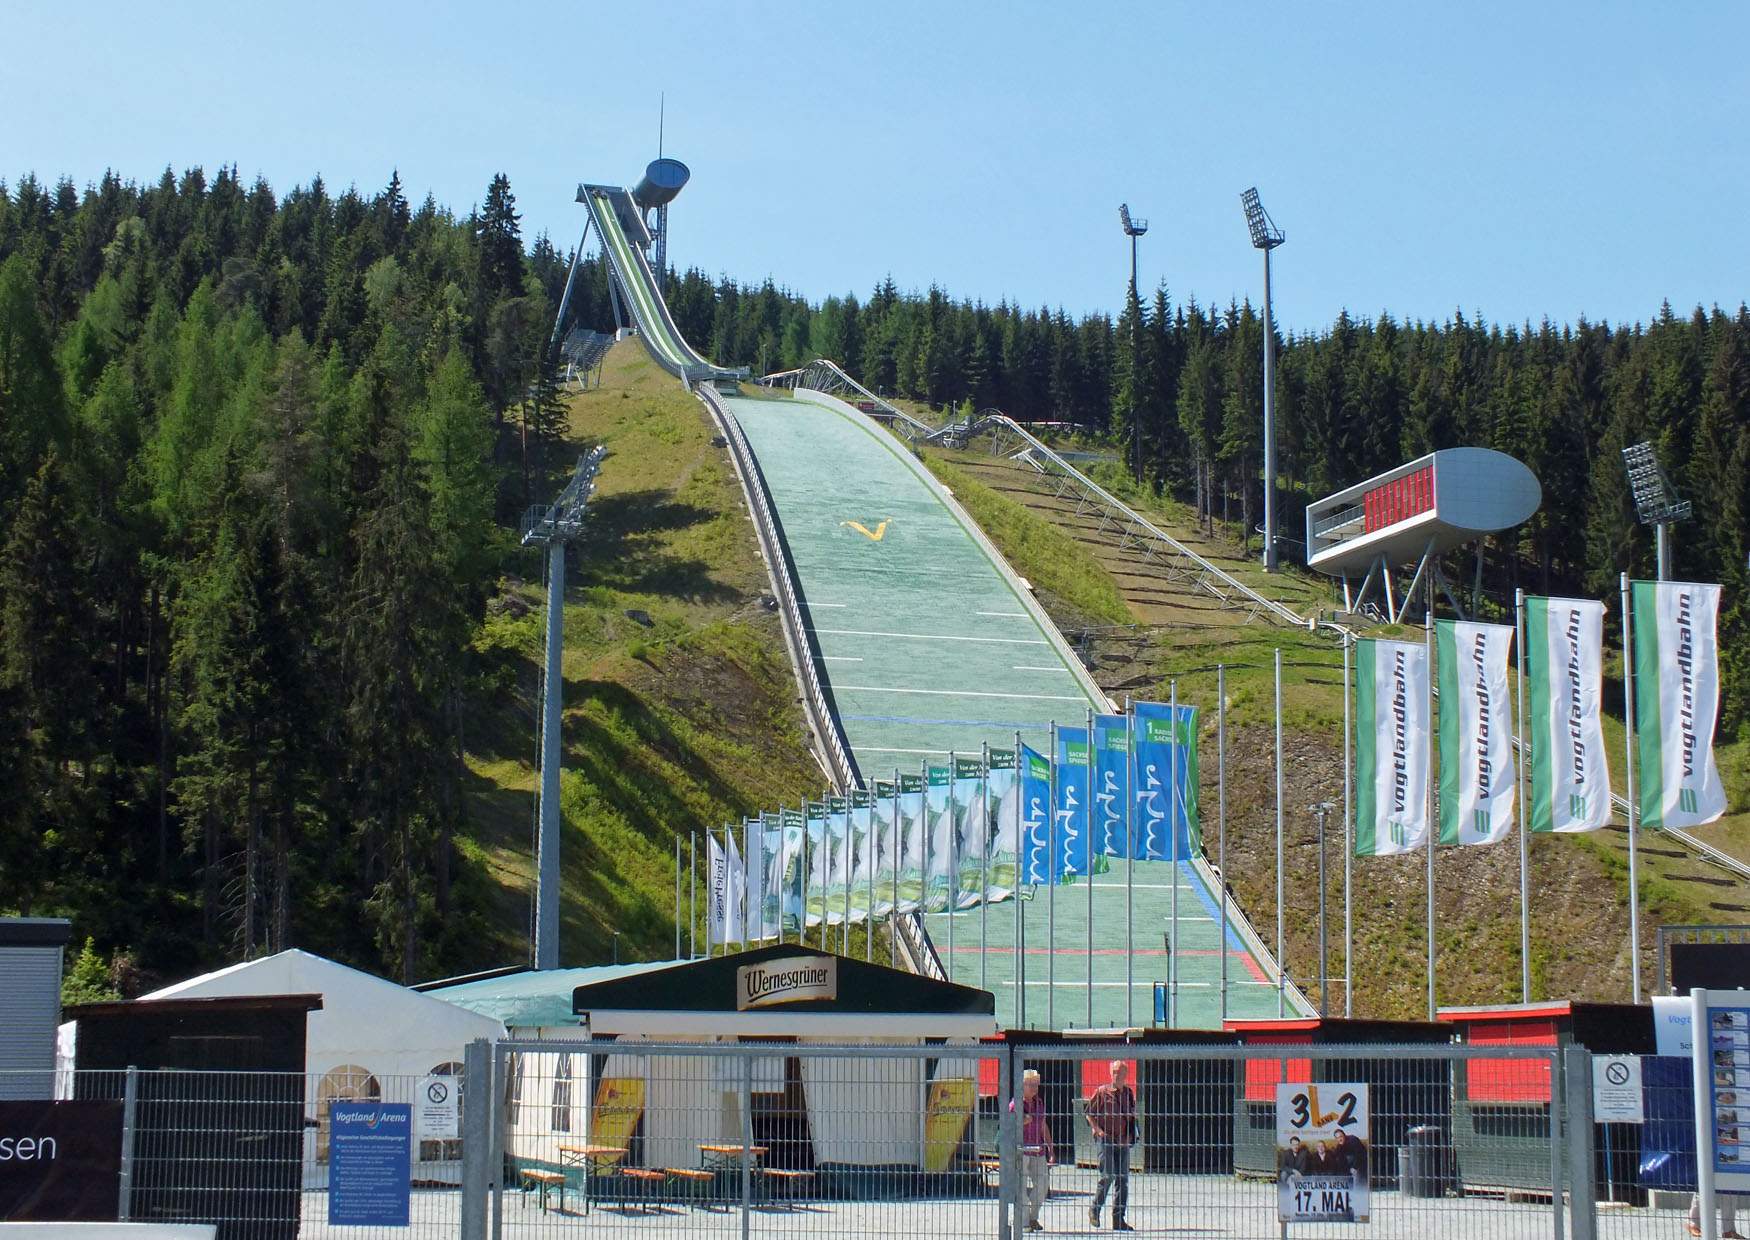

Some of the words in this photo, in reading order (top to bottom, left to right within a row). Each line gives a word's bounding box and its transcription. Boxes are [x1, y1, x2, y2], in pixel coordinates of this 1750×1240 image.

[1392, 650, 1407, 813] vogtlandbahn
[1472, 632, 1492, 800] vogtlandbahn
[1566, 608, 1586, 785] vogtlandbahn
[1677, 592, 1697, 777] vogtlandbahn
[745, 966, 828, 998] Wernesgrüner
[0, 1136, 56, 1160] sen
[336, 1112, 375, 1124] Vogtland
[381, 1112, 407, 1122] Arena
[1295, 1191, 1316, 1212] 17.
